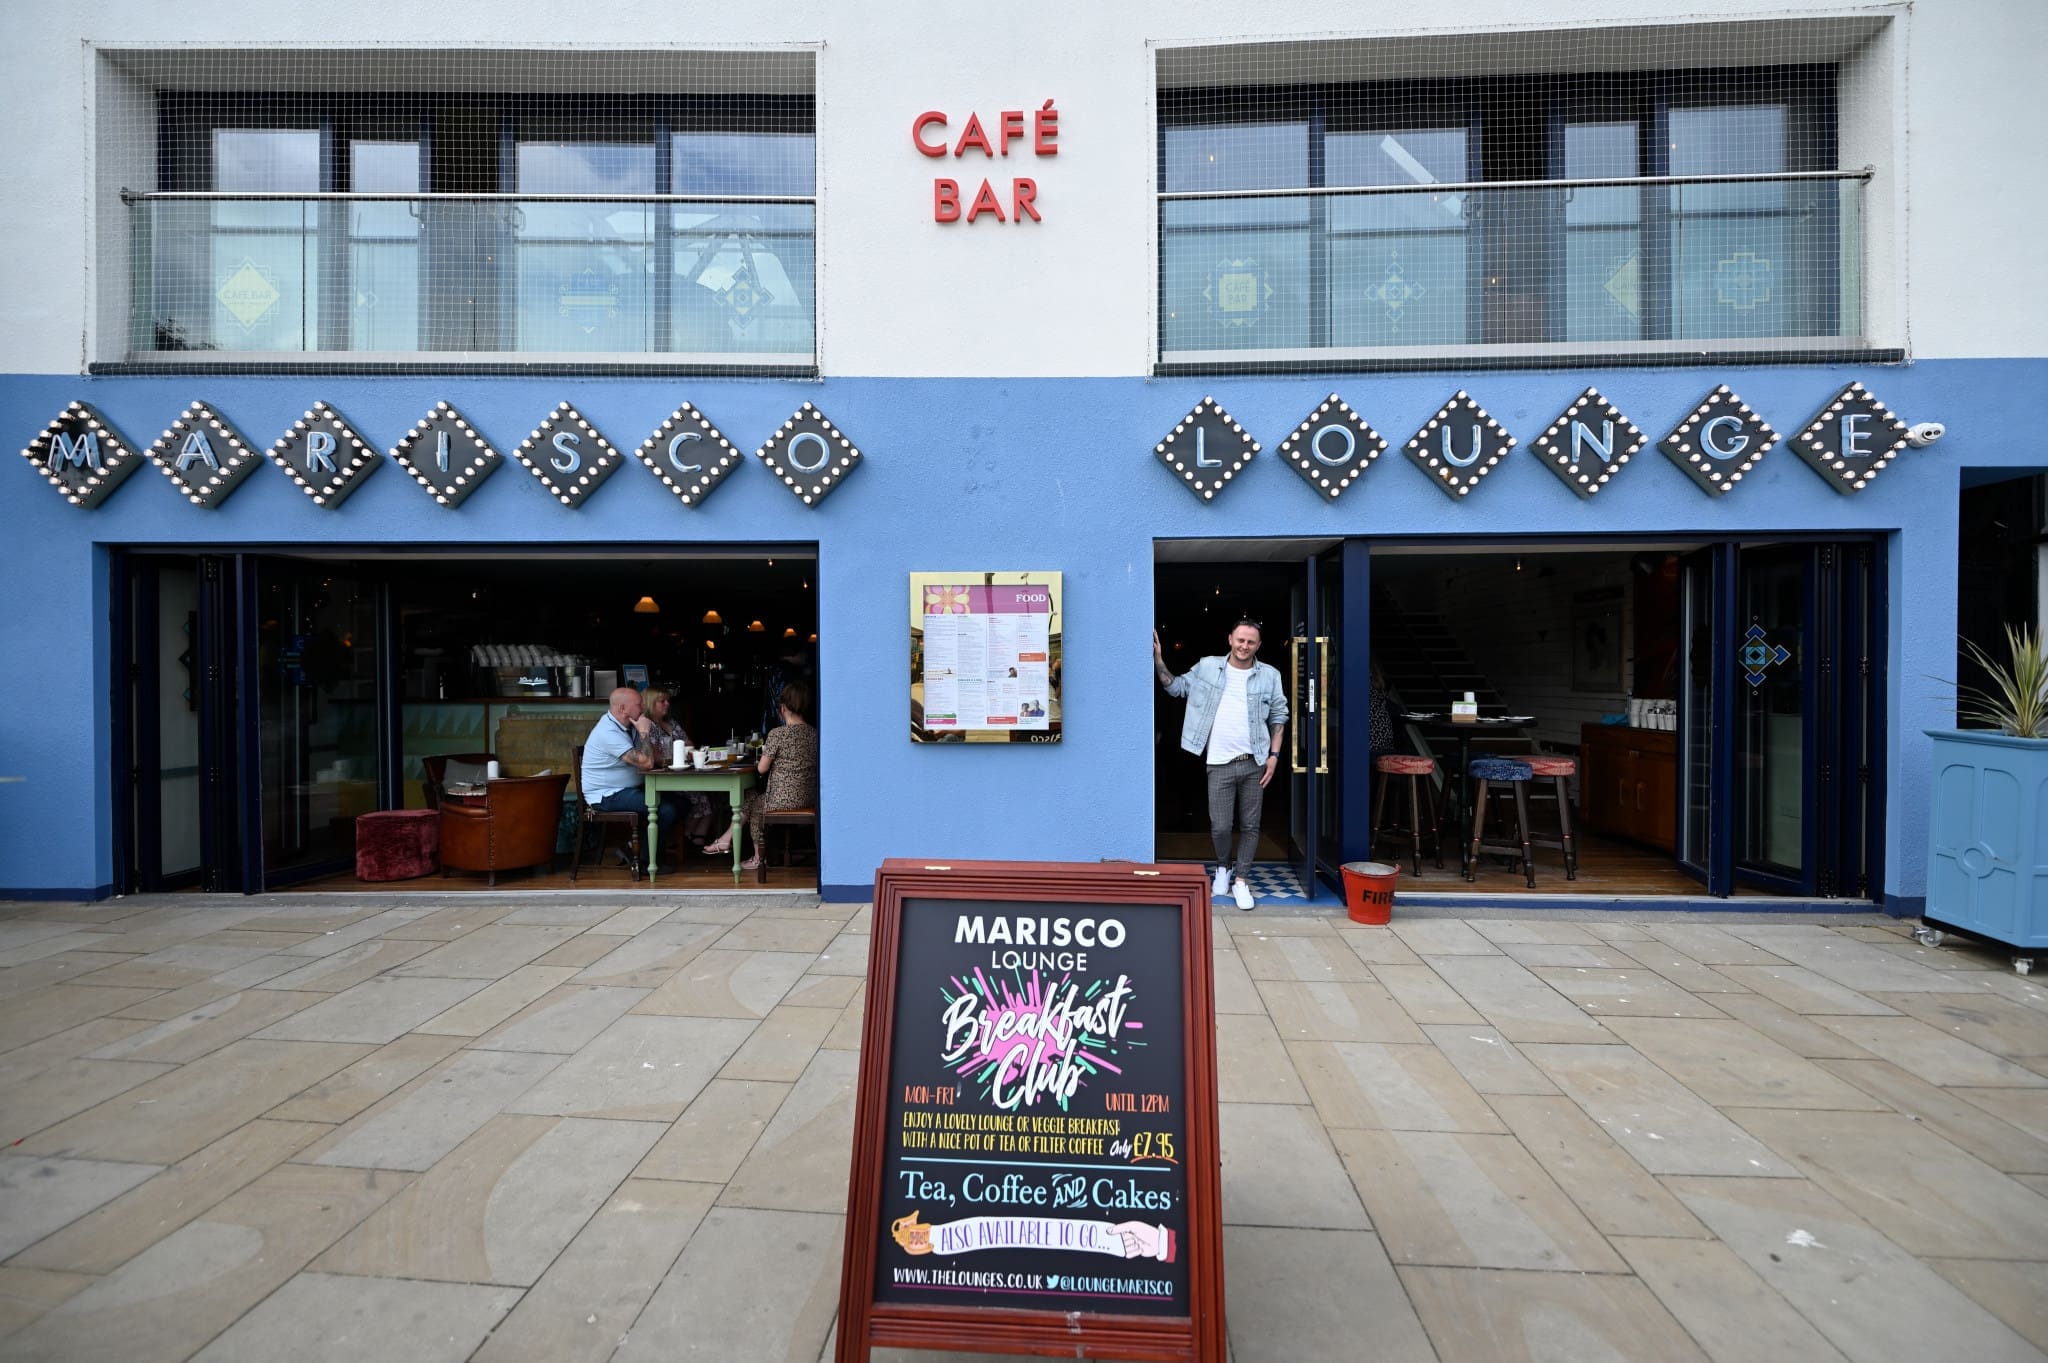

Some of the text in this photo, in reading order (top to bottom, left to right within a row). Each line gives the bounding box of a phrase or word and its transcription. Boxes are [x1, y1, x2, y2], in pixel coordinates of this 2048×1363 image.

[912, 98, 1058, 158] CAFÉ
[934, 177, 1042, 223] BAR
[47, 430, 831, 475] MARISCO
[1196, 414, 1873, 468] LOUNGE
[1015, 593, 1047, 603] FOOD
[954, 915, 1126, 948] MARISCO
[991, 951, 1087, 972] LOUNGE
[941, 974, 1132, 1062] Breakfast
[992, 1038, 1086, 1109] Club
[904, 1085, 955, 1105] MON-FRI
[1105, 1093, 1170, 1113] UNTIL 12PM
[903, 1111, 1120, 1136] ENJOY A LOVELY LOUNGE OR VEGGIE BREAKFAST
[902, 1131, 1174, 1159] WITH A NICE POT OF TEA OR FILTER COFFEE Only £7.95
[900, 1170, 1171, 1210] Tea, Coffee AND Cakes
[941, 1224, 972, 1252] ALSO
[979, 1220, 1052, 1247] AVAILABLE
[1058, 1221, 1074, 1247] TO
[893, 1267, 1173, 1296] WWW.THELOUNGES.CO.UK @LOUNGEMARISCO
